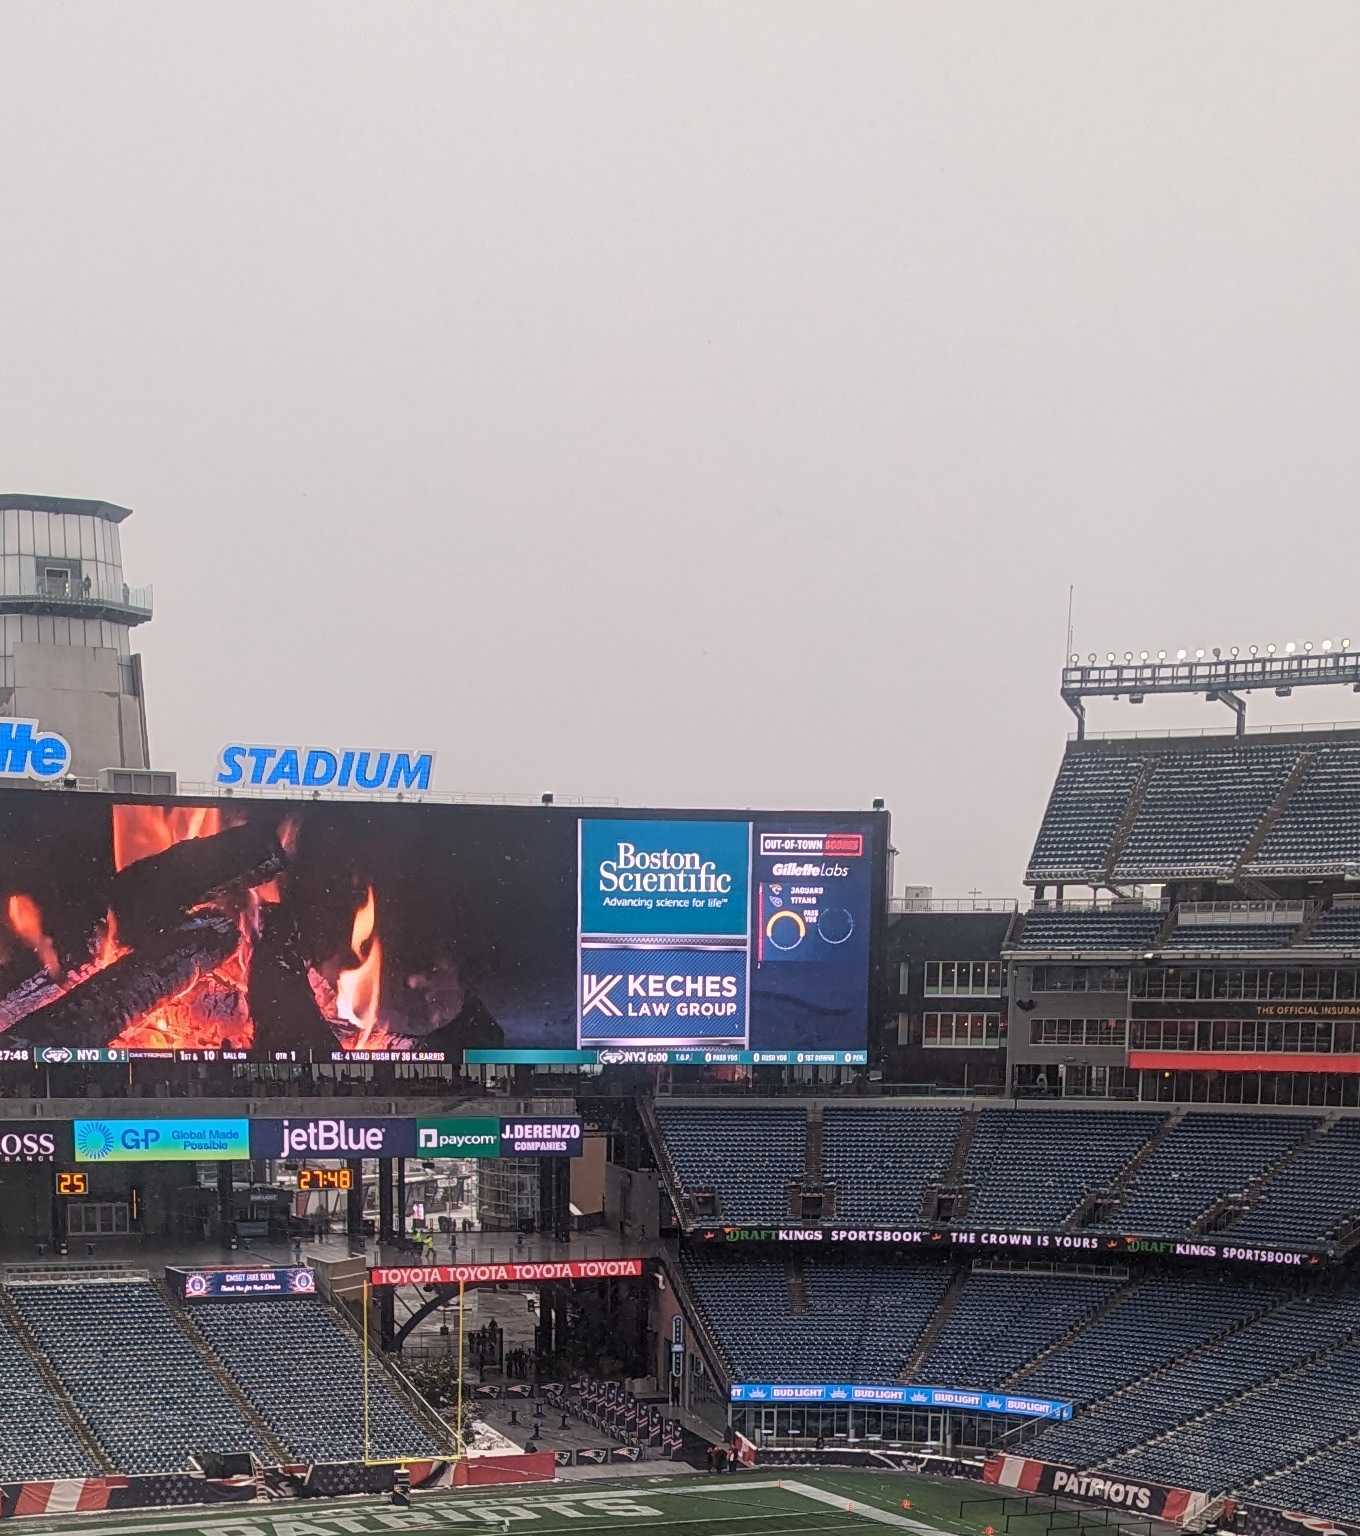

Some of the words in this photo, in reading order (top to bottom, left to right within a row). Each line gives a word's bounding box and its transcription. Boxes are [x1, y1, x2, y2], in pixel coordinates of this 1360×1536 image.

[216, 745, 433, 791] STADIUM
[764, 838, 823, 850] OUT-OF-TOWN
[617, 843, 700, 871] Boston
[599, 860, 732, 894] Scientific
[790, 886, 824, 895] JAGUARS
[603, 896, 653, 910] Advancing
[656, 896, 690, 909] science
[691, 896, 706, 909] for
[790, 896, 817, 905] TITANS
[627, 975, 737, 998] KECHES
[627, 1003, 670, 1017] LAW
[675, 1003, 737, 1017] GROUP
[1256, 1006, 1274, 1016] THE
[1276, 1006, 1319, 1016] OFFICIAL
[77, 1050, 100, 1062] NYJ
[107, 1050, 118, 1062] 0
[170, 1129, 206, 1141] Global
[207, 1129, 240, 1141] Made
[280, 1119, 385, 1158] jetBlue
[500, 1123, 580, 1140] J.DERENZO
[182, 1140, 229, 1151] Possible
[438, 1133, 496, 1148] paycom
[513, 1140, 567, 1151] COMPANIES
[59, 1174, 84, 1193] 25
[298, 1169, 351, 1189] 27:48
[951, 1231, 975, 1244] THE
[980, 1232, 1032, 1247] CROWN
[1036, 1235, 1051, 1248] IS
[1053, 1236, 1100, 1250] YOURS
[378, 1266, 442, 1284] TOYOTA
[446, 1264, 510, 1282] TOYOTA
[513, 1262, 573, 1280] TOYOTA
[577, 1259, 638, 1278] TOYOTA
[773, 1387, 793, 1398] BUD
[794, 1388, 823, 1398] LIGHT
[853, 1389, 874, 1399] BUD
[875, 1390, 904, 1400] LIGHT
[934, 1393, 953, 1404] BUD
[953, 1394, 980, 1406] LIGHT
[1007, 1400, 1026, 1411] BUD
[1026, 1402, 1051, 1413] LIGHT
[1052, 1471, 1152, 1509] PATRIOTS
